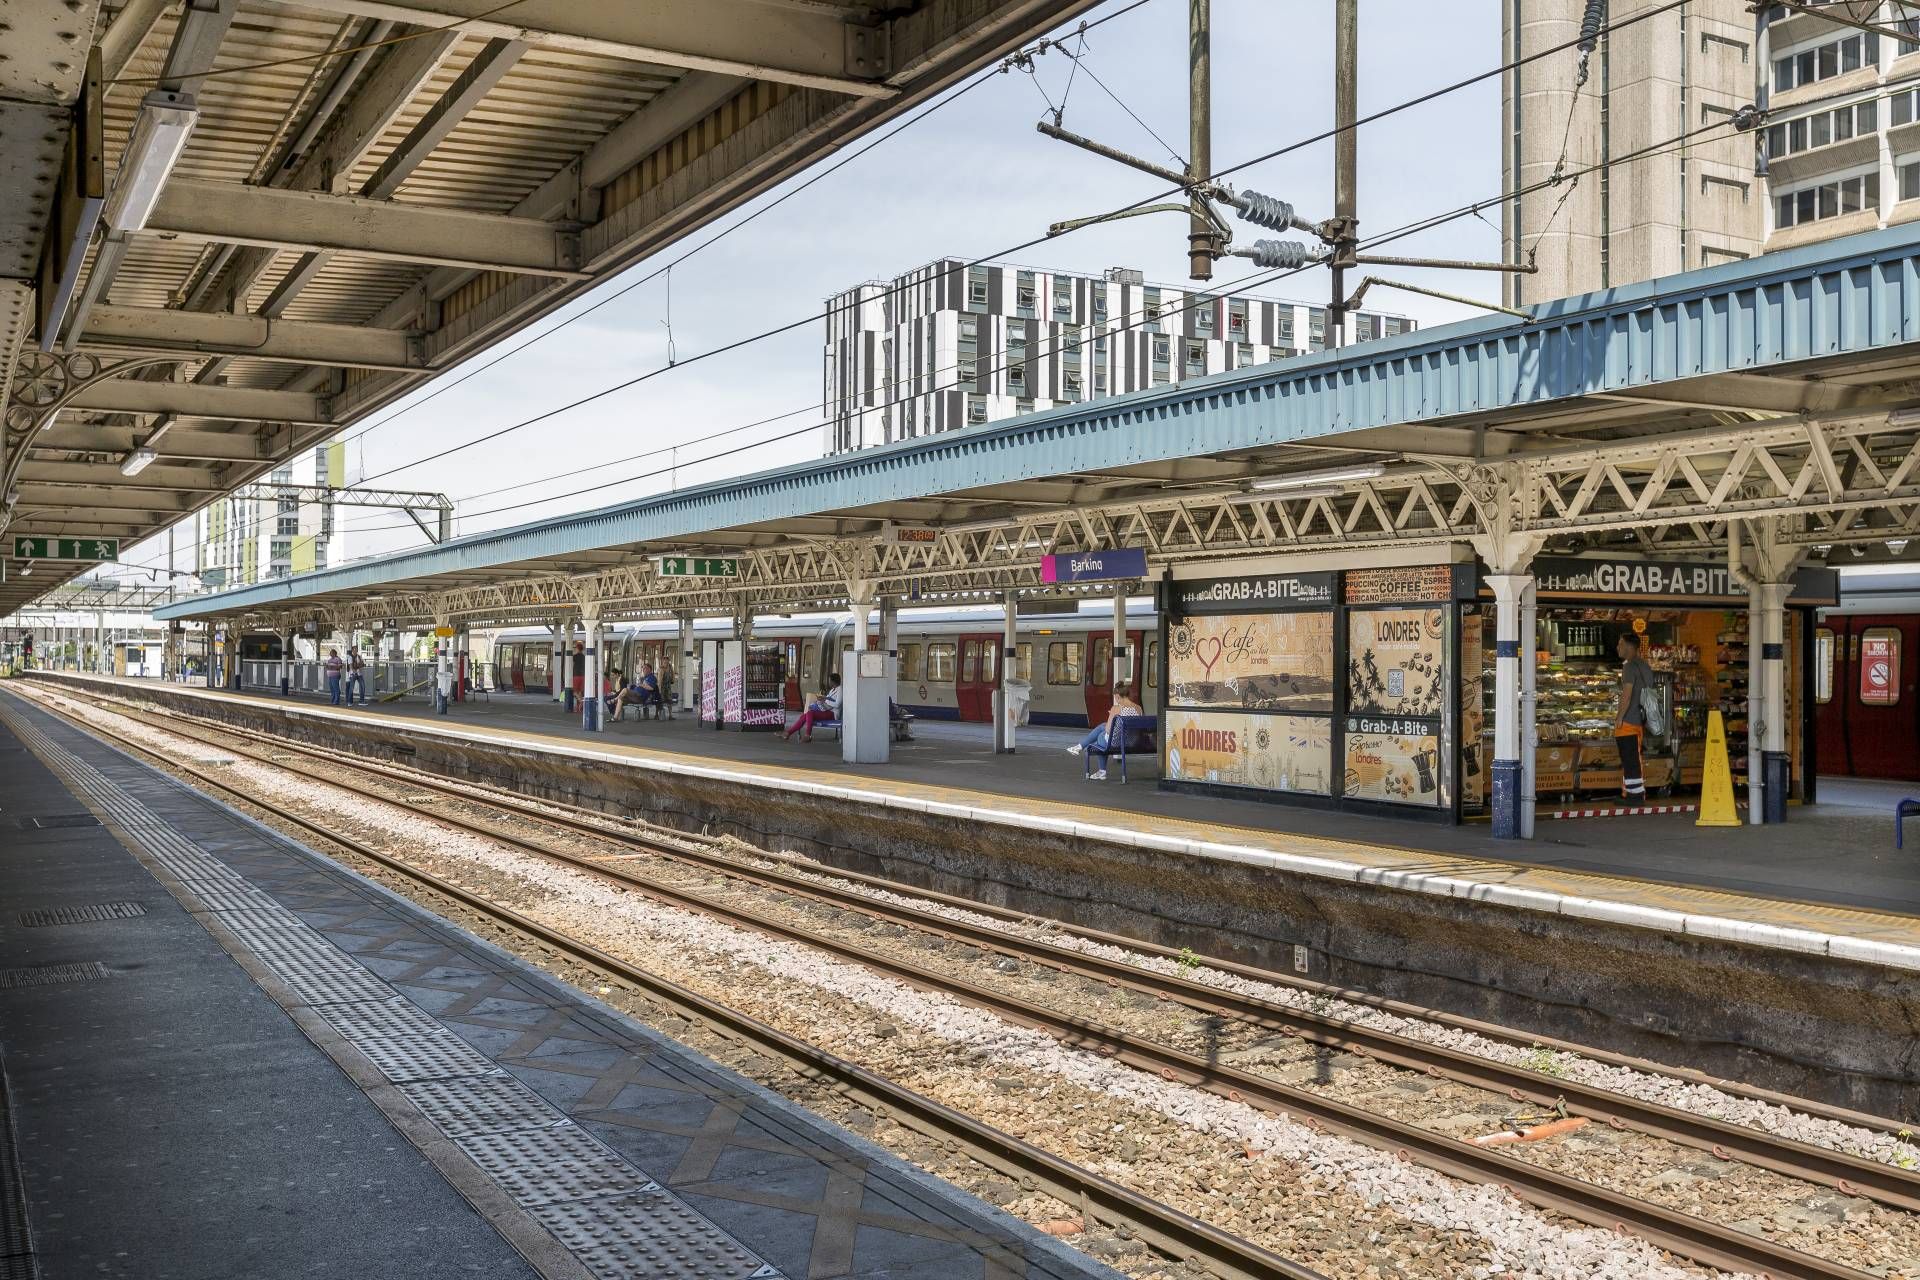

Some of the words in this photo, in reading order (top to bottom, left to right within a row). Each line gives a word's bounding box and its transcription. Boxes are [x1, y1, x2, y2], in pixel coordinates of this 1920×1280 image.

[1070, 558, 1103, 572] Barking
[1379, 581, 1421, 594] COFFEE
[1598, 563, 1740, 595] GRAB-A-BITE
[1213, 578, 1298, 601] GRAB-A-BITE
[1420, 592, 1437, 600] HOT
[1377, 620, 1420, 642] LONDRES
[1222, 622, 1256, 664] Café
[1872, 642, 1886, 651] NO
[1360, 719, 1428, 735] Grab-A-Bite
[1182, 728, 1237, 754] LONDRES
